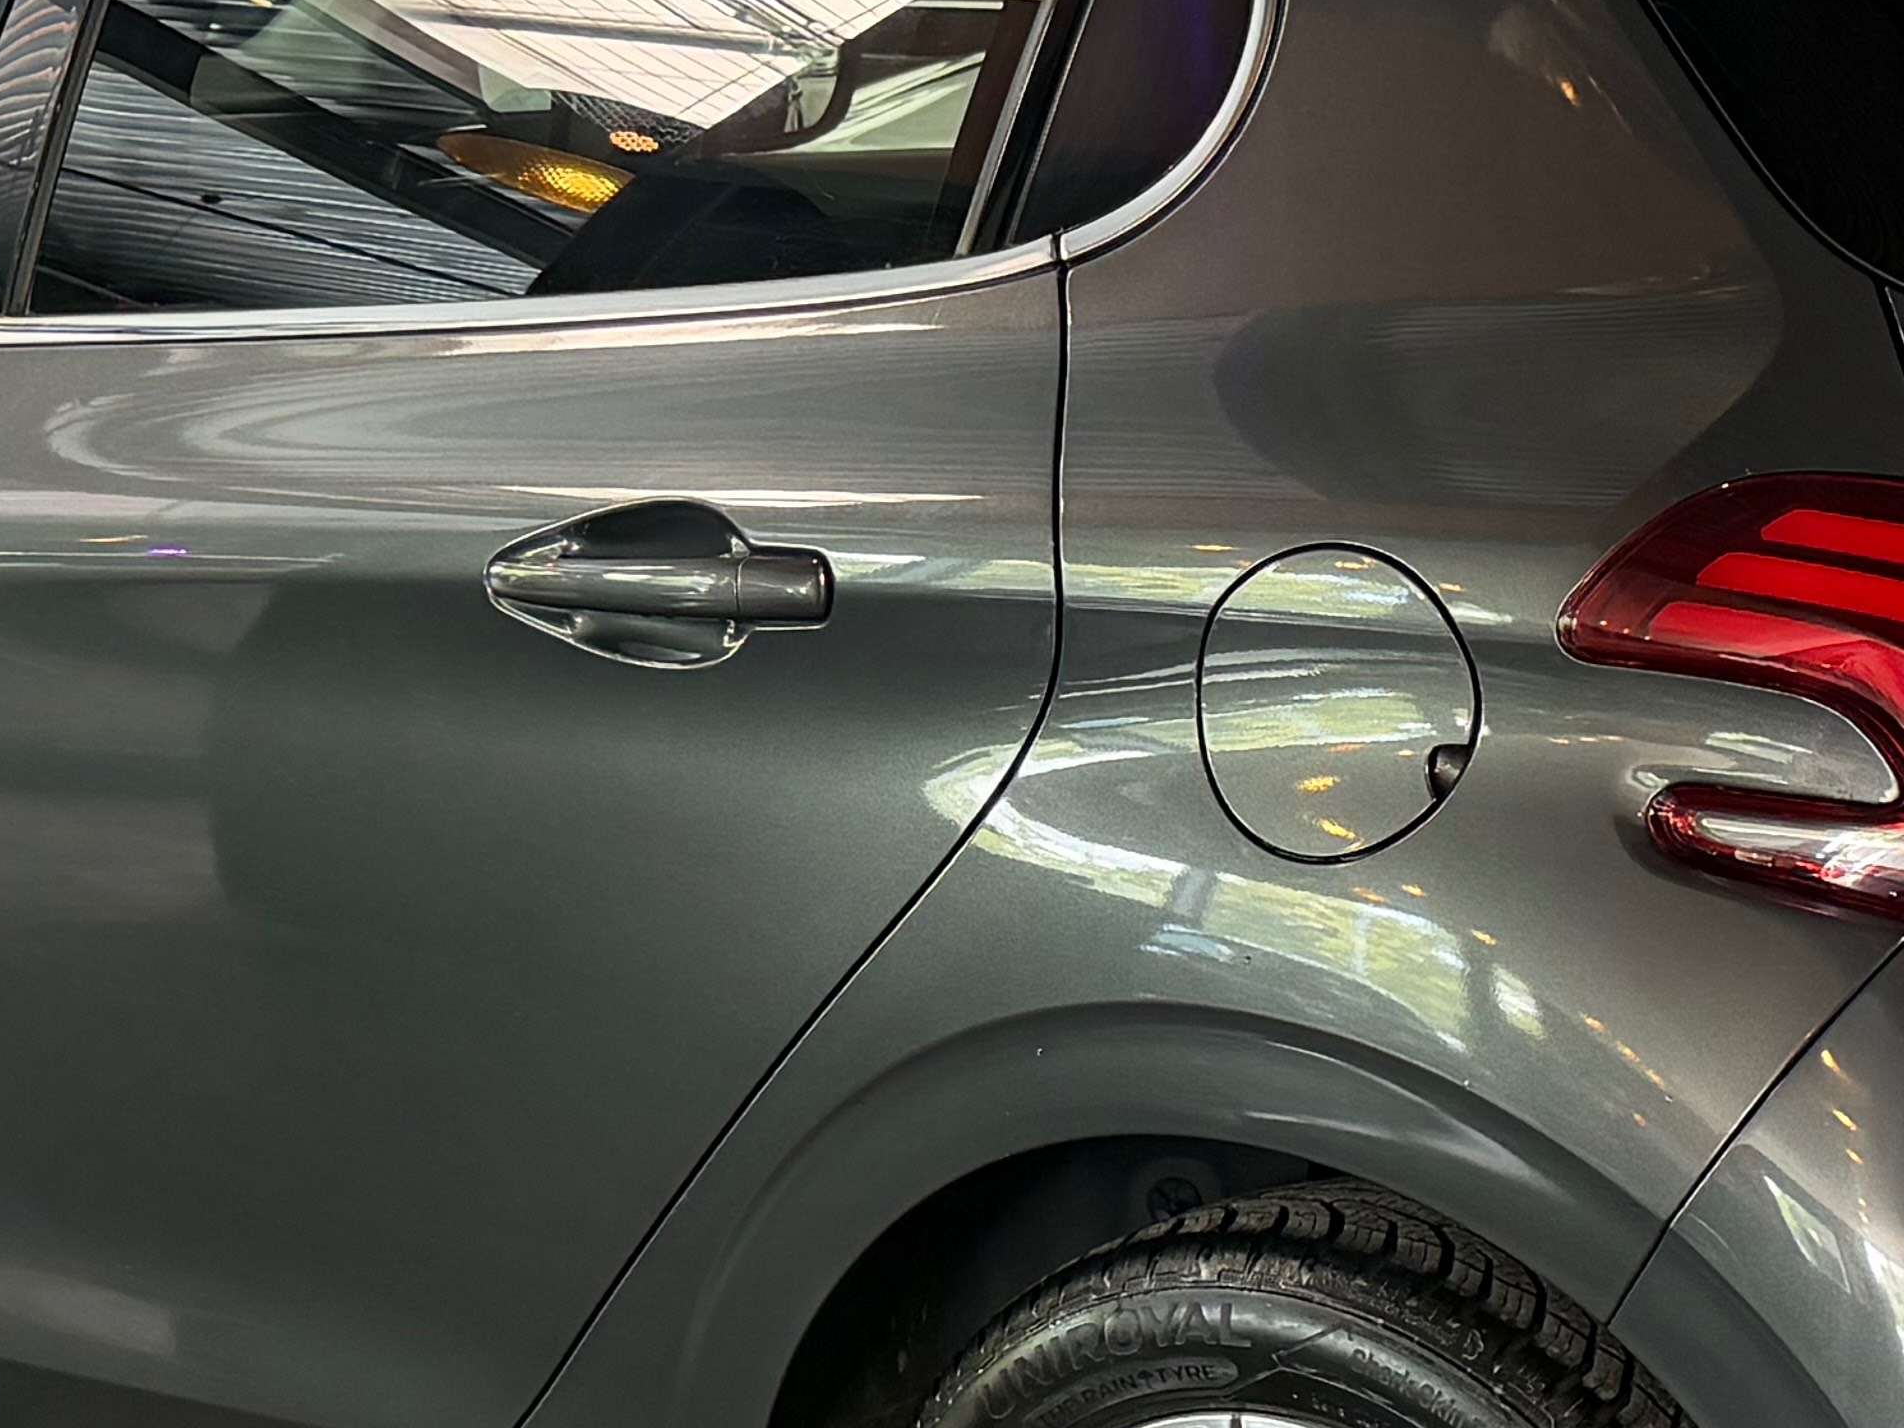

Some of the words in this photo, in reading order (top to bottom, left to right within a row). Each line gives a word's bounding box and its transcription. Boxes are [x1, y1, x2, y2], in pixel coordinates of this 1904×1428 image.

[980, 1302, 1252, 1420] UNIROYAL
[1082, 1374, 1138, 1405] RAIN
[1158, 1362, 1219, 1387] TYRE
